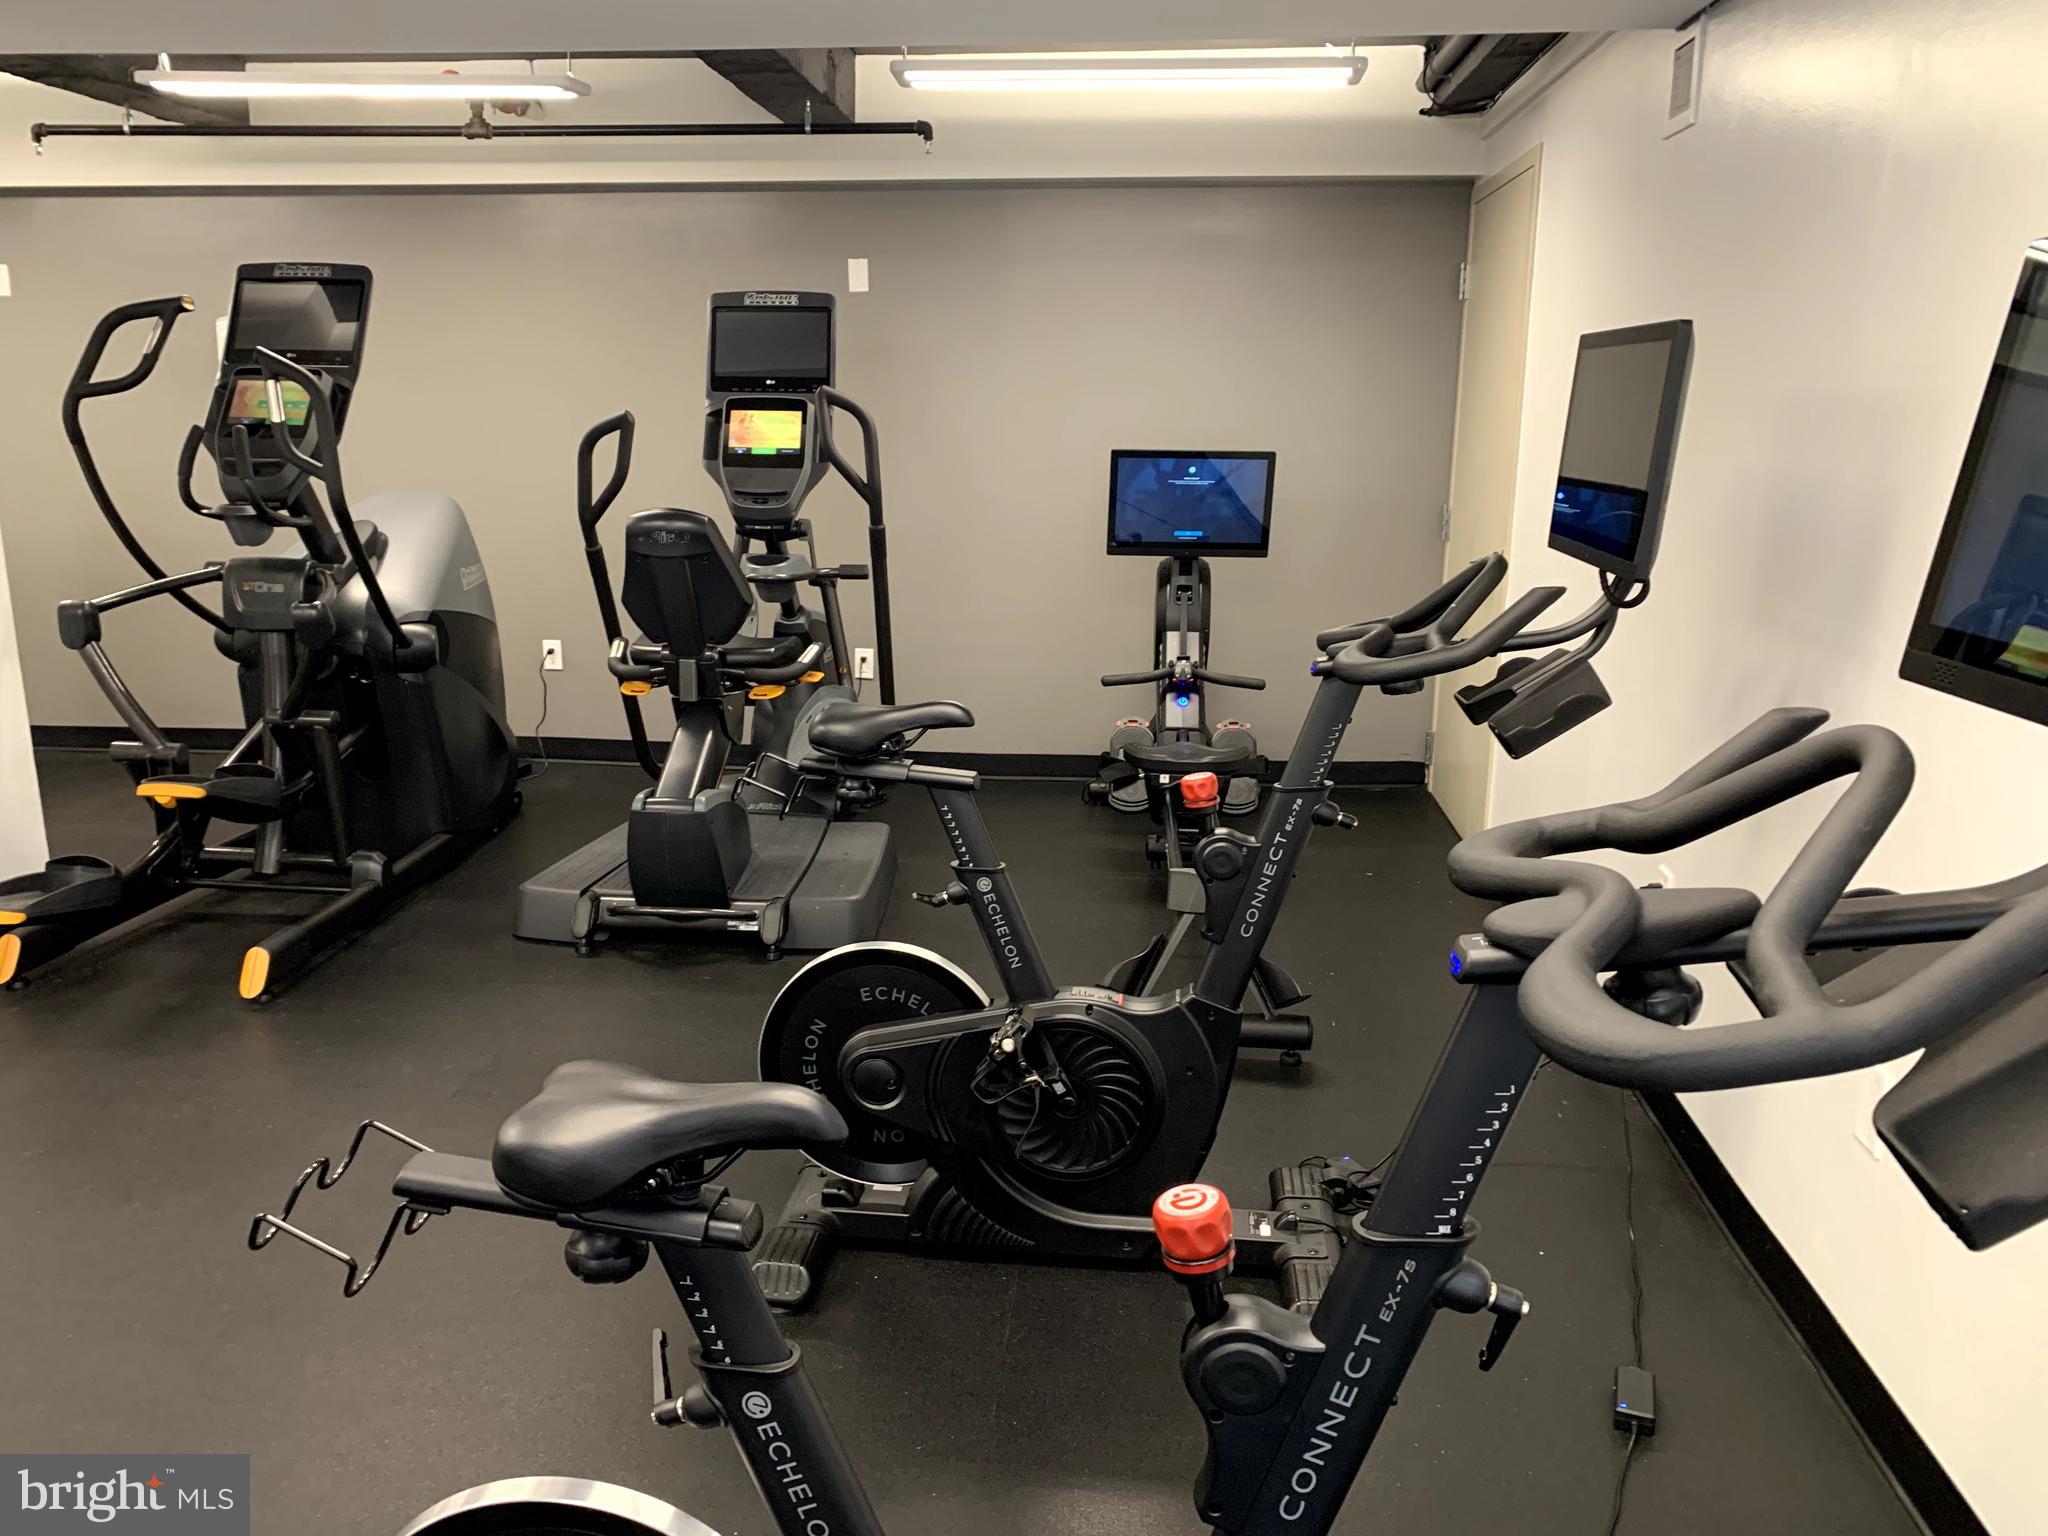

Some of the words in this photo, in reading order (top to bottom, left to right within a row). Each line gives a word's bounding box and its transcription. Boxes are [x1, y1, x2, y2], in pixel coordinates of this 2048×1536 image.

[1240, 832, 1287, 938] CONNECT
[983, 892, 1023, 969] ECHELON
[860, 986, 931, 1016] ECHEL
[802, 1019, 827, 1092] HELON
[1510, 1085, 1516, 1094] 1
[1501, 1103, 1508, 1111] 2
[1493, 1120, 1500, 1129] 3
[1484, 1138, 1490, 1147] 4
[1475, 1156, 1482, 1164] 5
[1466, 1173, 1473, 1182] 6
[1458, 1191, 1465, 1199] 7
[1450, 1208, 1456, 1216] 8
[1279, 1323, 1381, 1520] CONNECT
[756, 1421, 829, 1536] ECHELO
